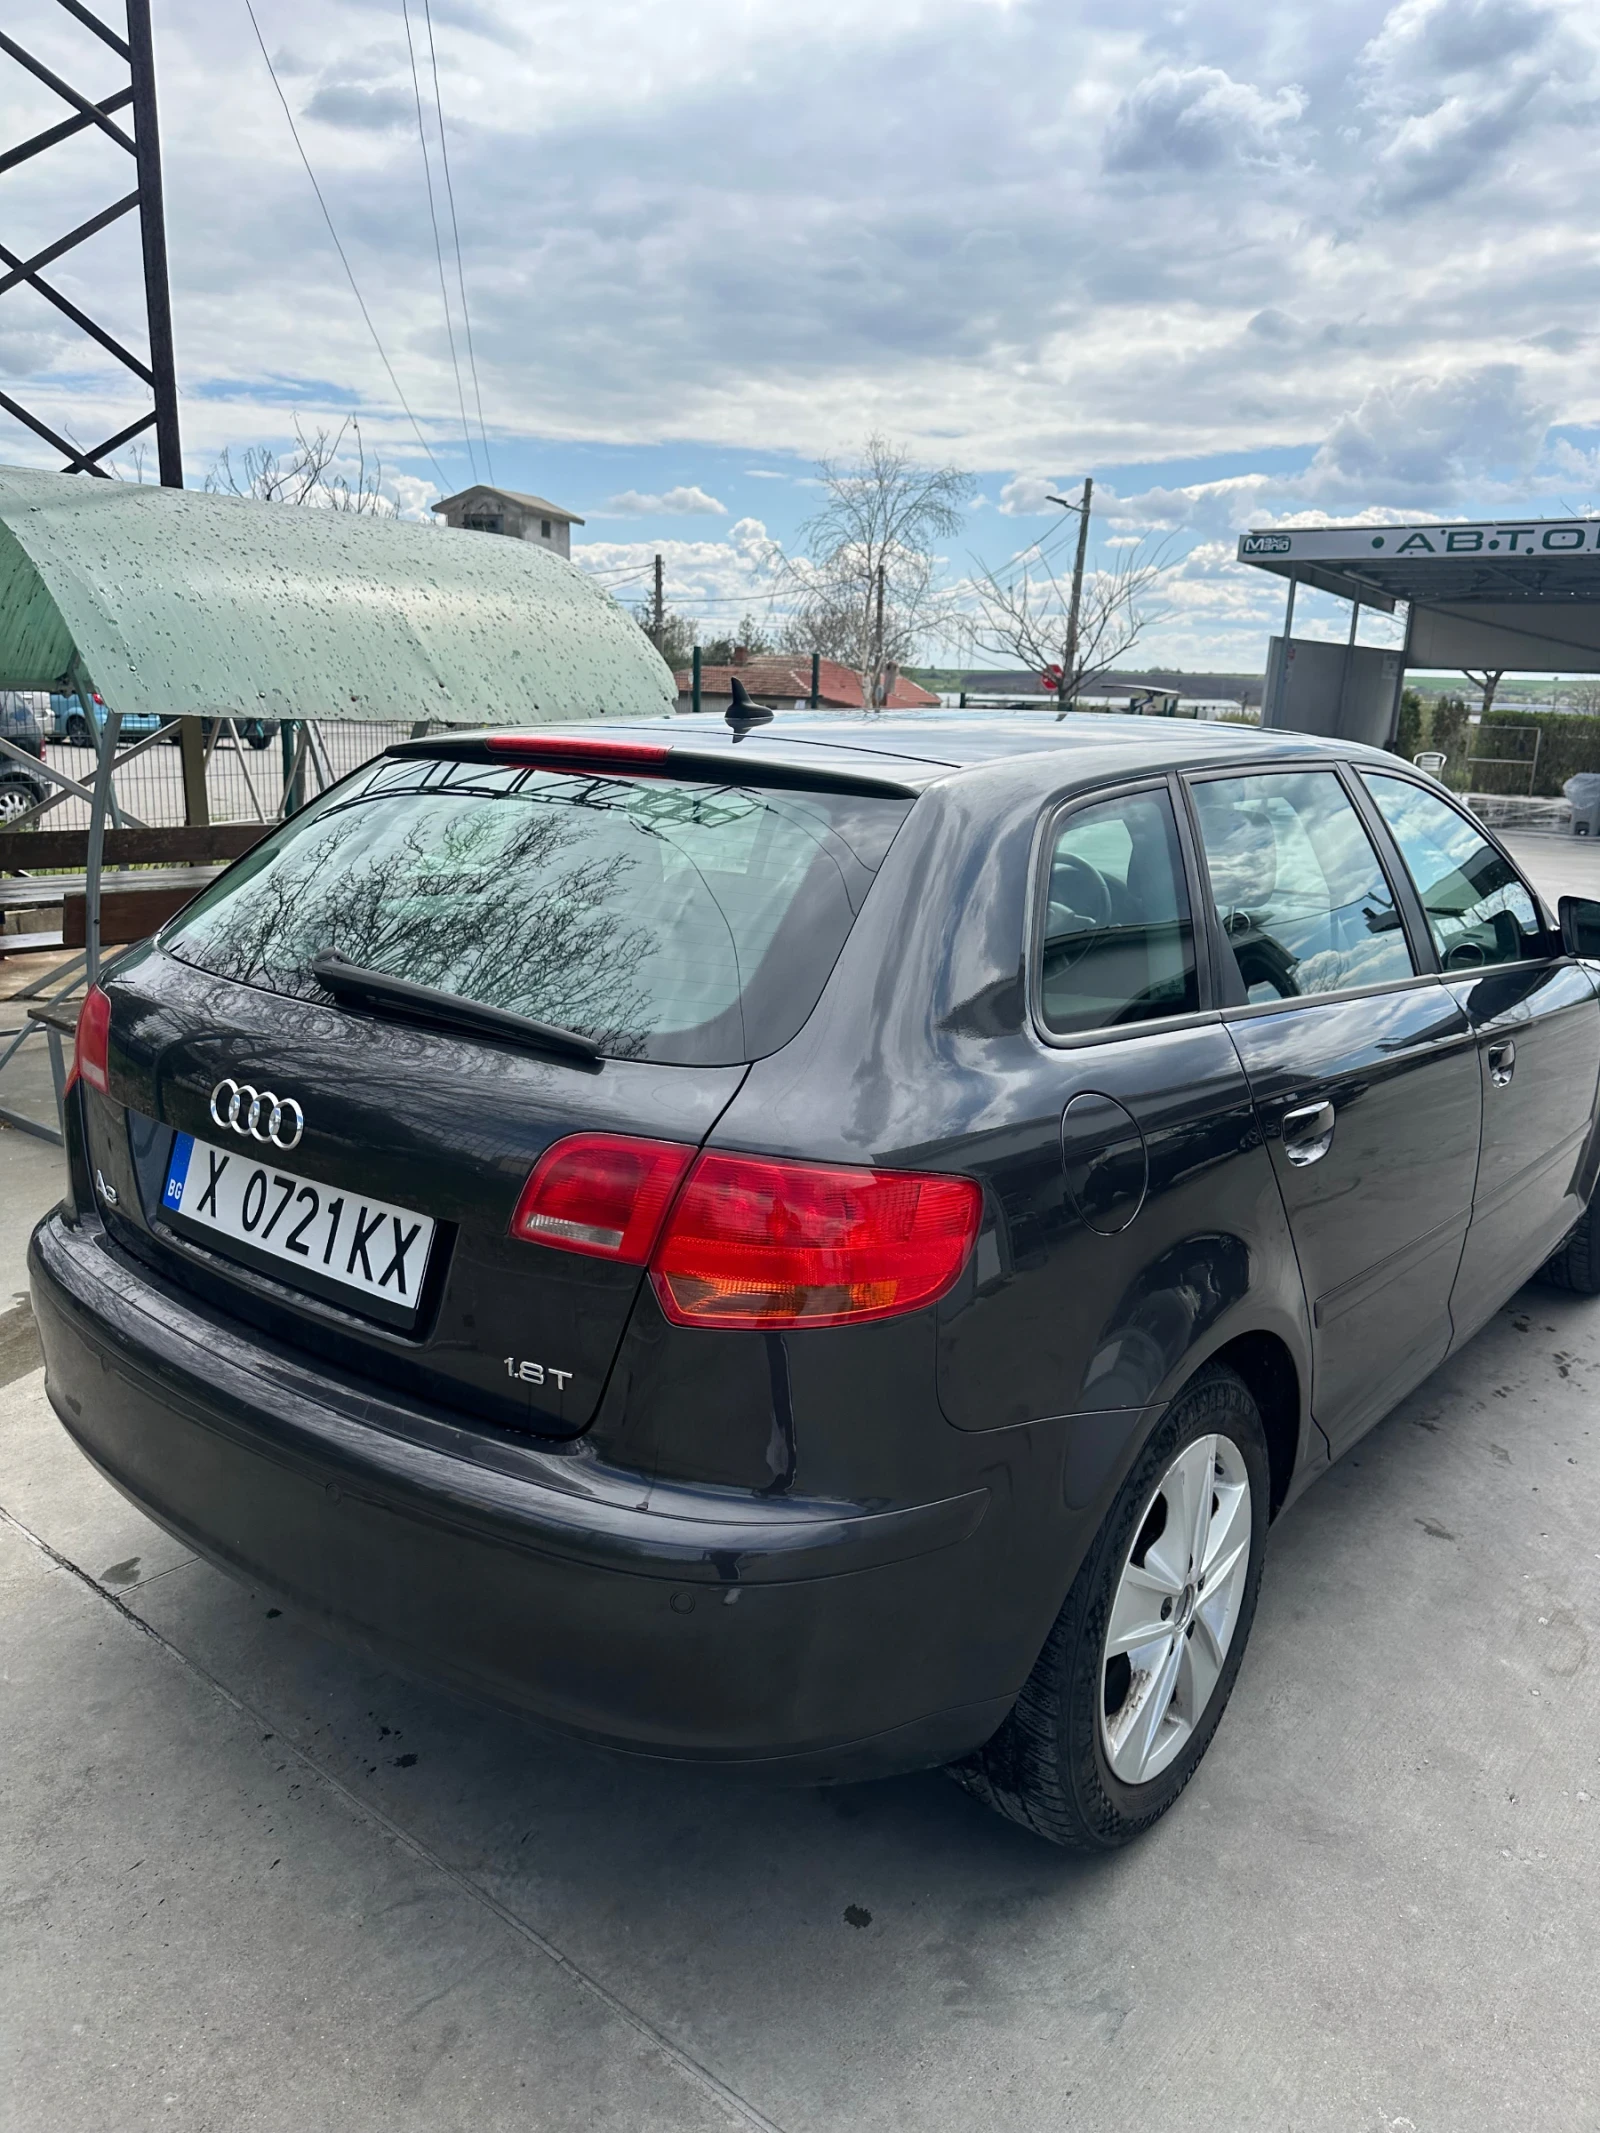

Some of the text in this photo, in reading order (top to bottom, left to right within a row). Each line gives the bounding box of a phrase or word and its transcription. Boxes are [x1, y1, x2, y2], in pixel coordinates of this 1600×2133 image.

[1396, 528, 1600, 554] АВТО
[167, 1178, 183, 1200] BG
[196, 1150, 230, 1219] X
